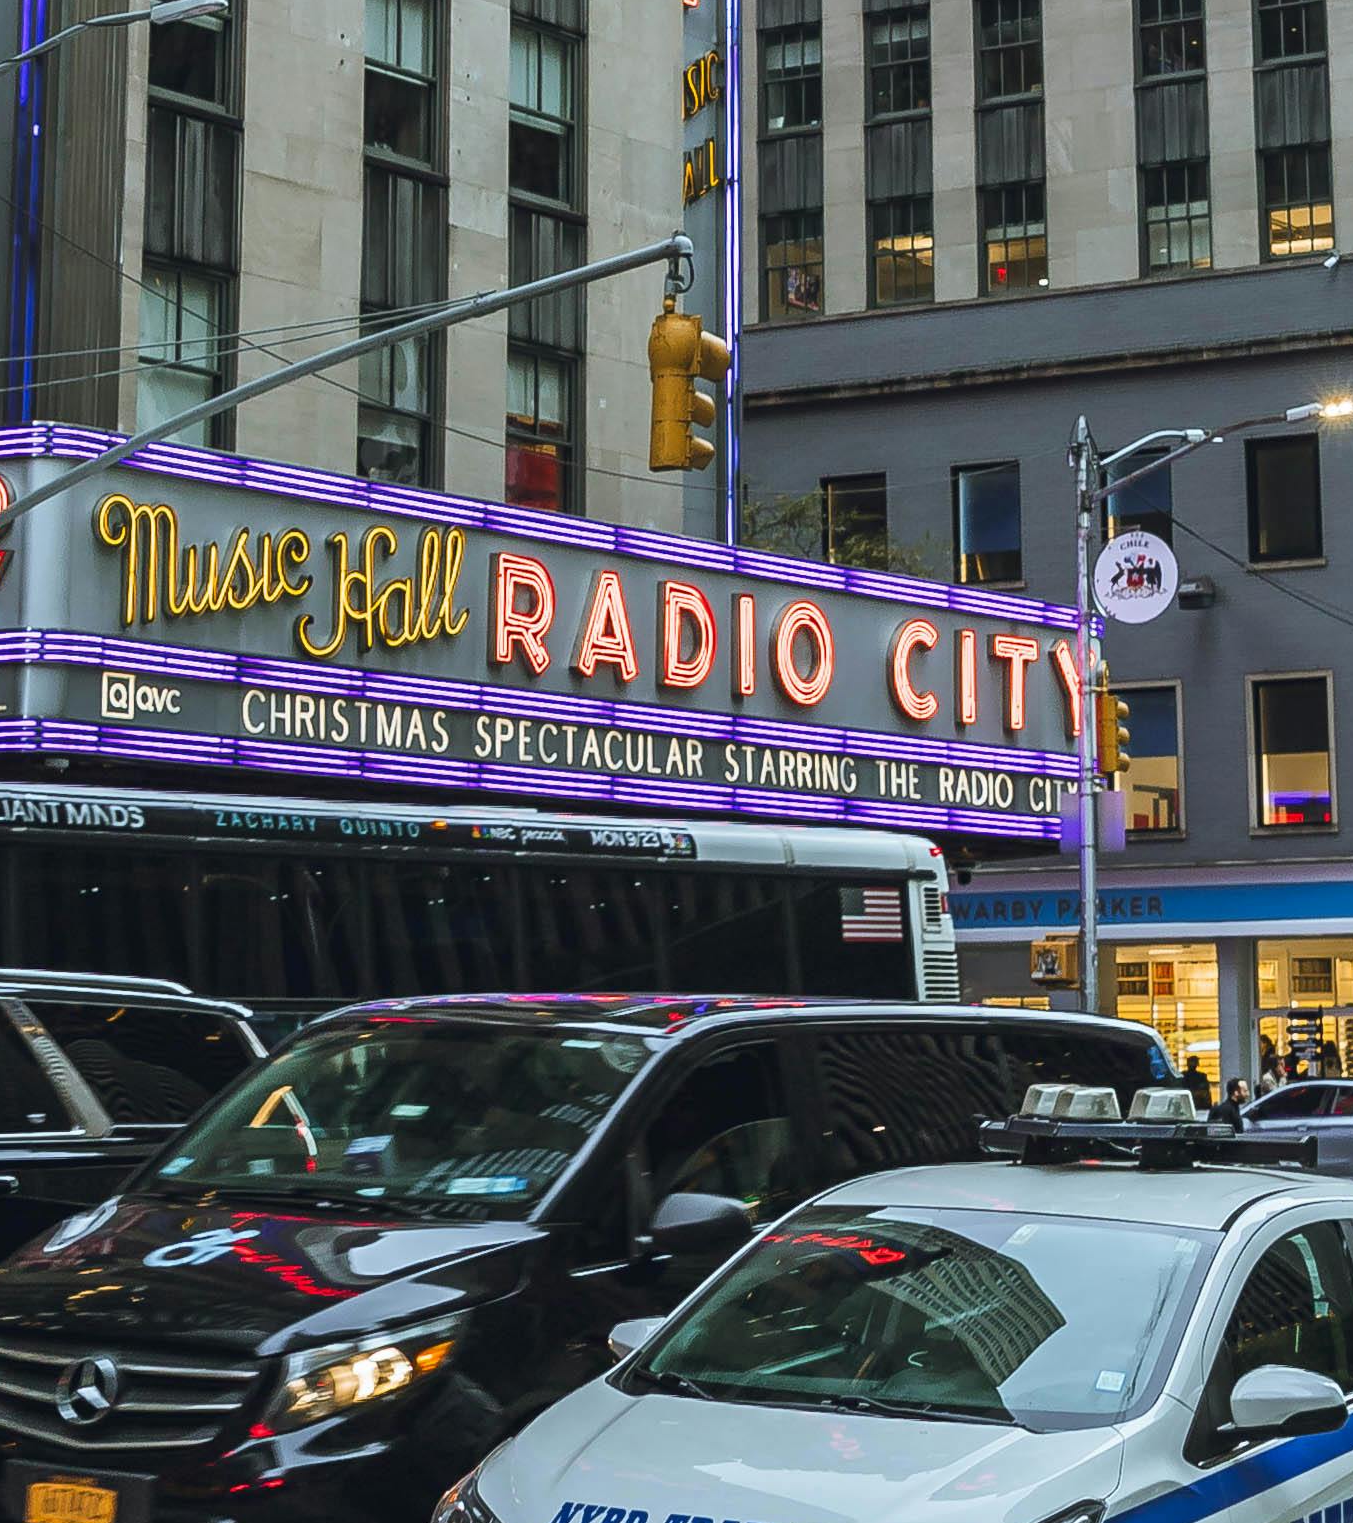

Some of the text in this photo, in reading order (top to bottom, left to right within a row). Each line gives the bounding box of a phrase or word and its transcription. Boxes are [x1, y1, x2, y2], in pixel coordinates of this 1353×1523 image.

[1119, 539, 1150, 551] CHILE
[95, 491, 471, 658] Music Hall
[488, 551, 837, 708] RADIO
[136, 685, 181, 714] QVC
[241, 688, 450, 754] CHRISTMAS
[473, 714, 704, 779] SPECTACULAR
[723, 743, 858, 795] STARRING
[875, 760, 922, 800] THE
[938, 767, 1015, 809] RADIO
[215, 810, 422, 839] ZACHARY QUINTO
[949, 893, 1044, 923] WARBY
